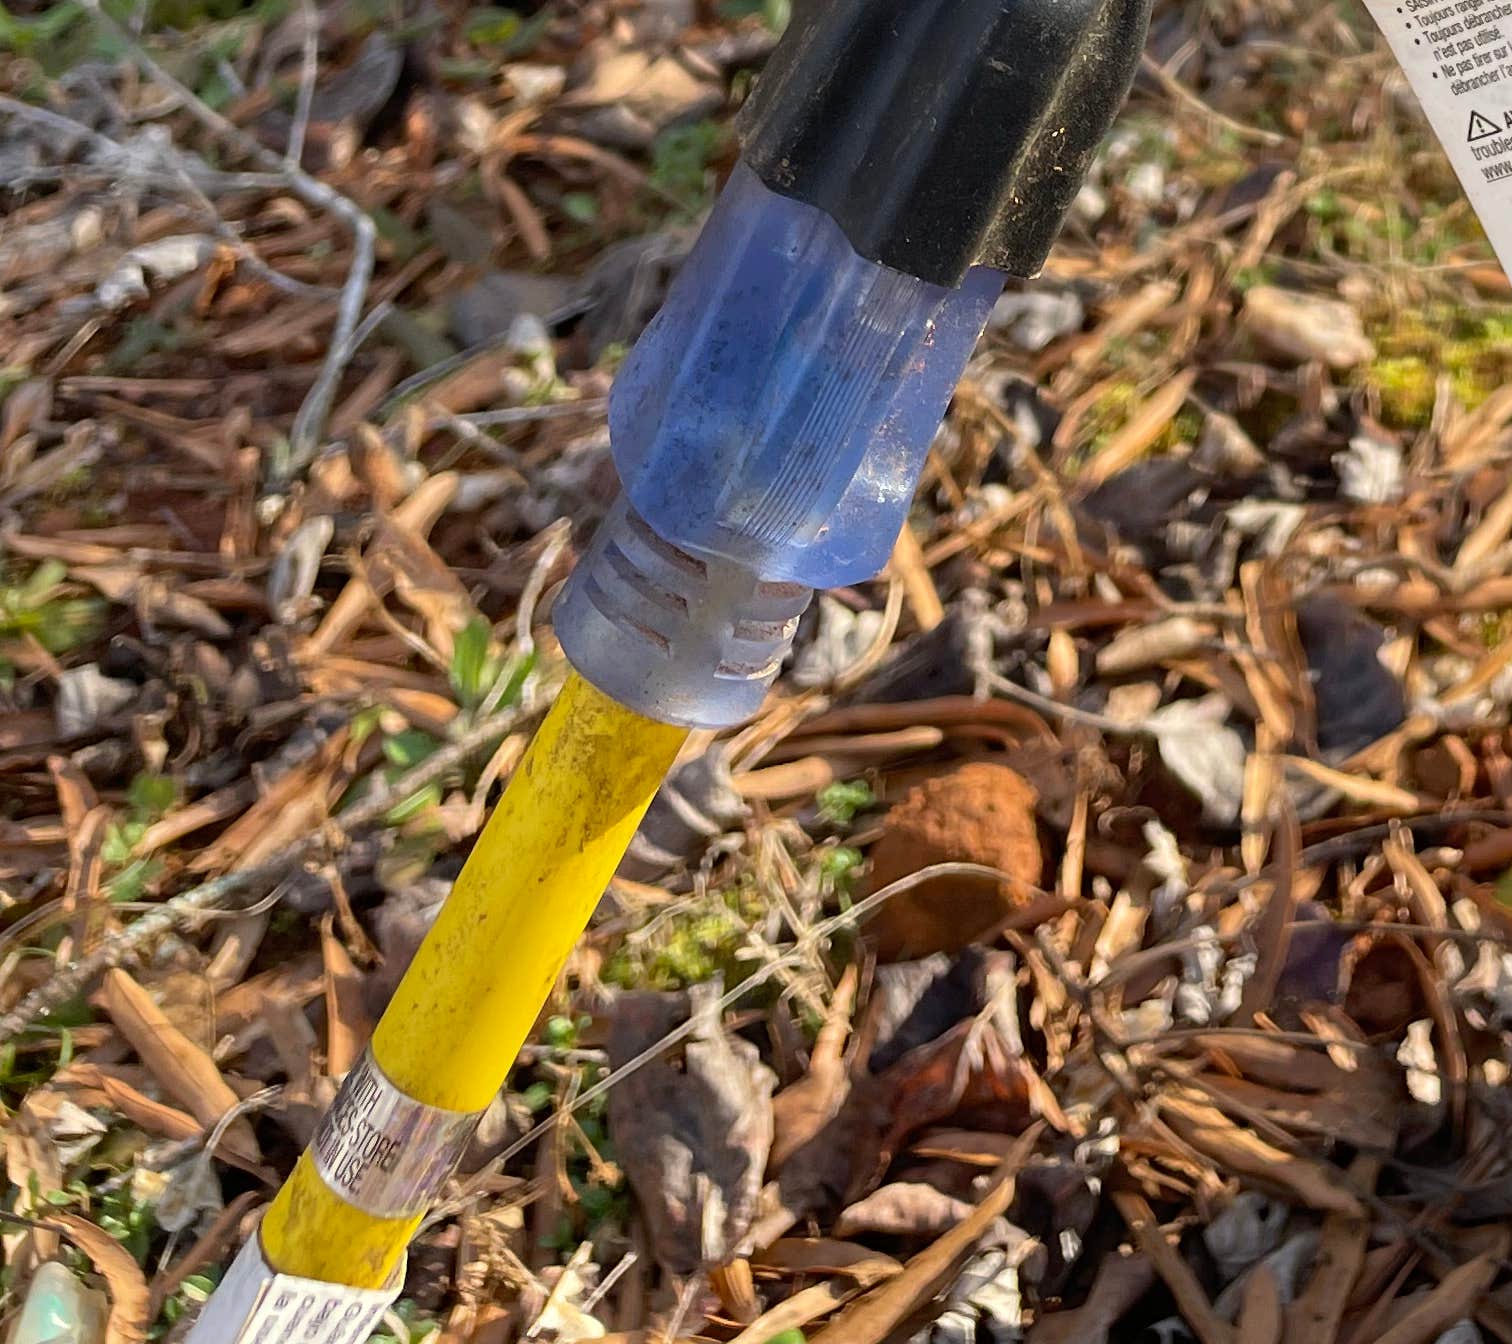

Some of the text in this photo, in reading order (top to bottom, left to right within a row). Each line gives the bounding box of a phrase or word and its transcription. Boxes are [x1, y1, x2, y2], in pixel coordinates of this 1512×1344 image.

[1440, 62, 1456, 79] Ne
[1455, 58, 1475, 76] pas
[1491, 44, 1509, 60] sur
